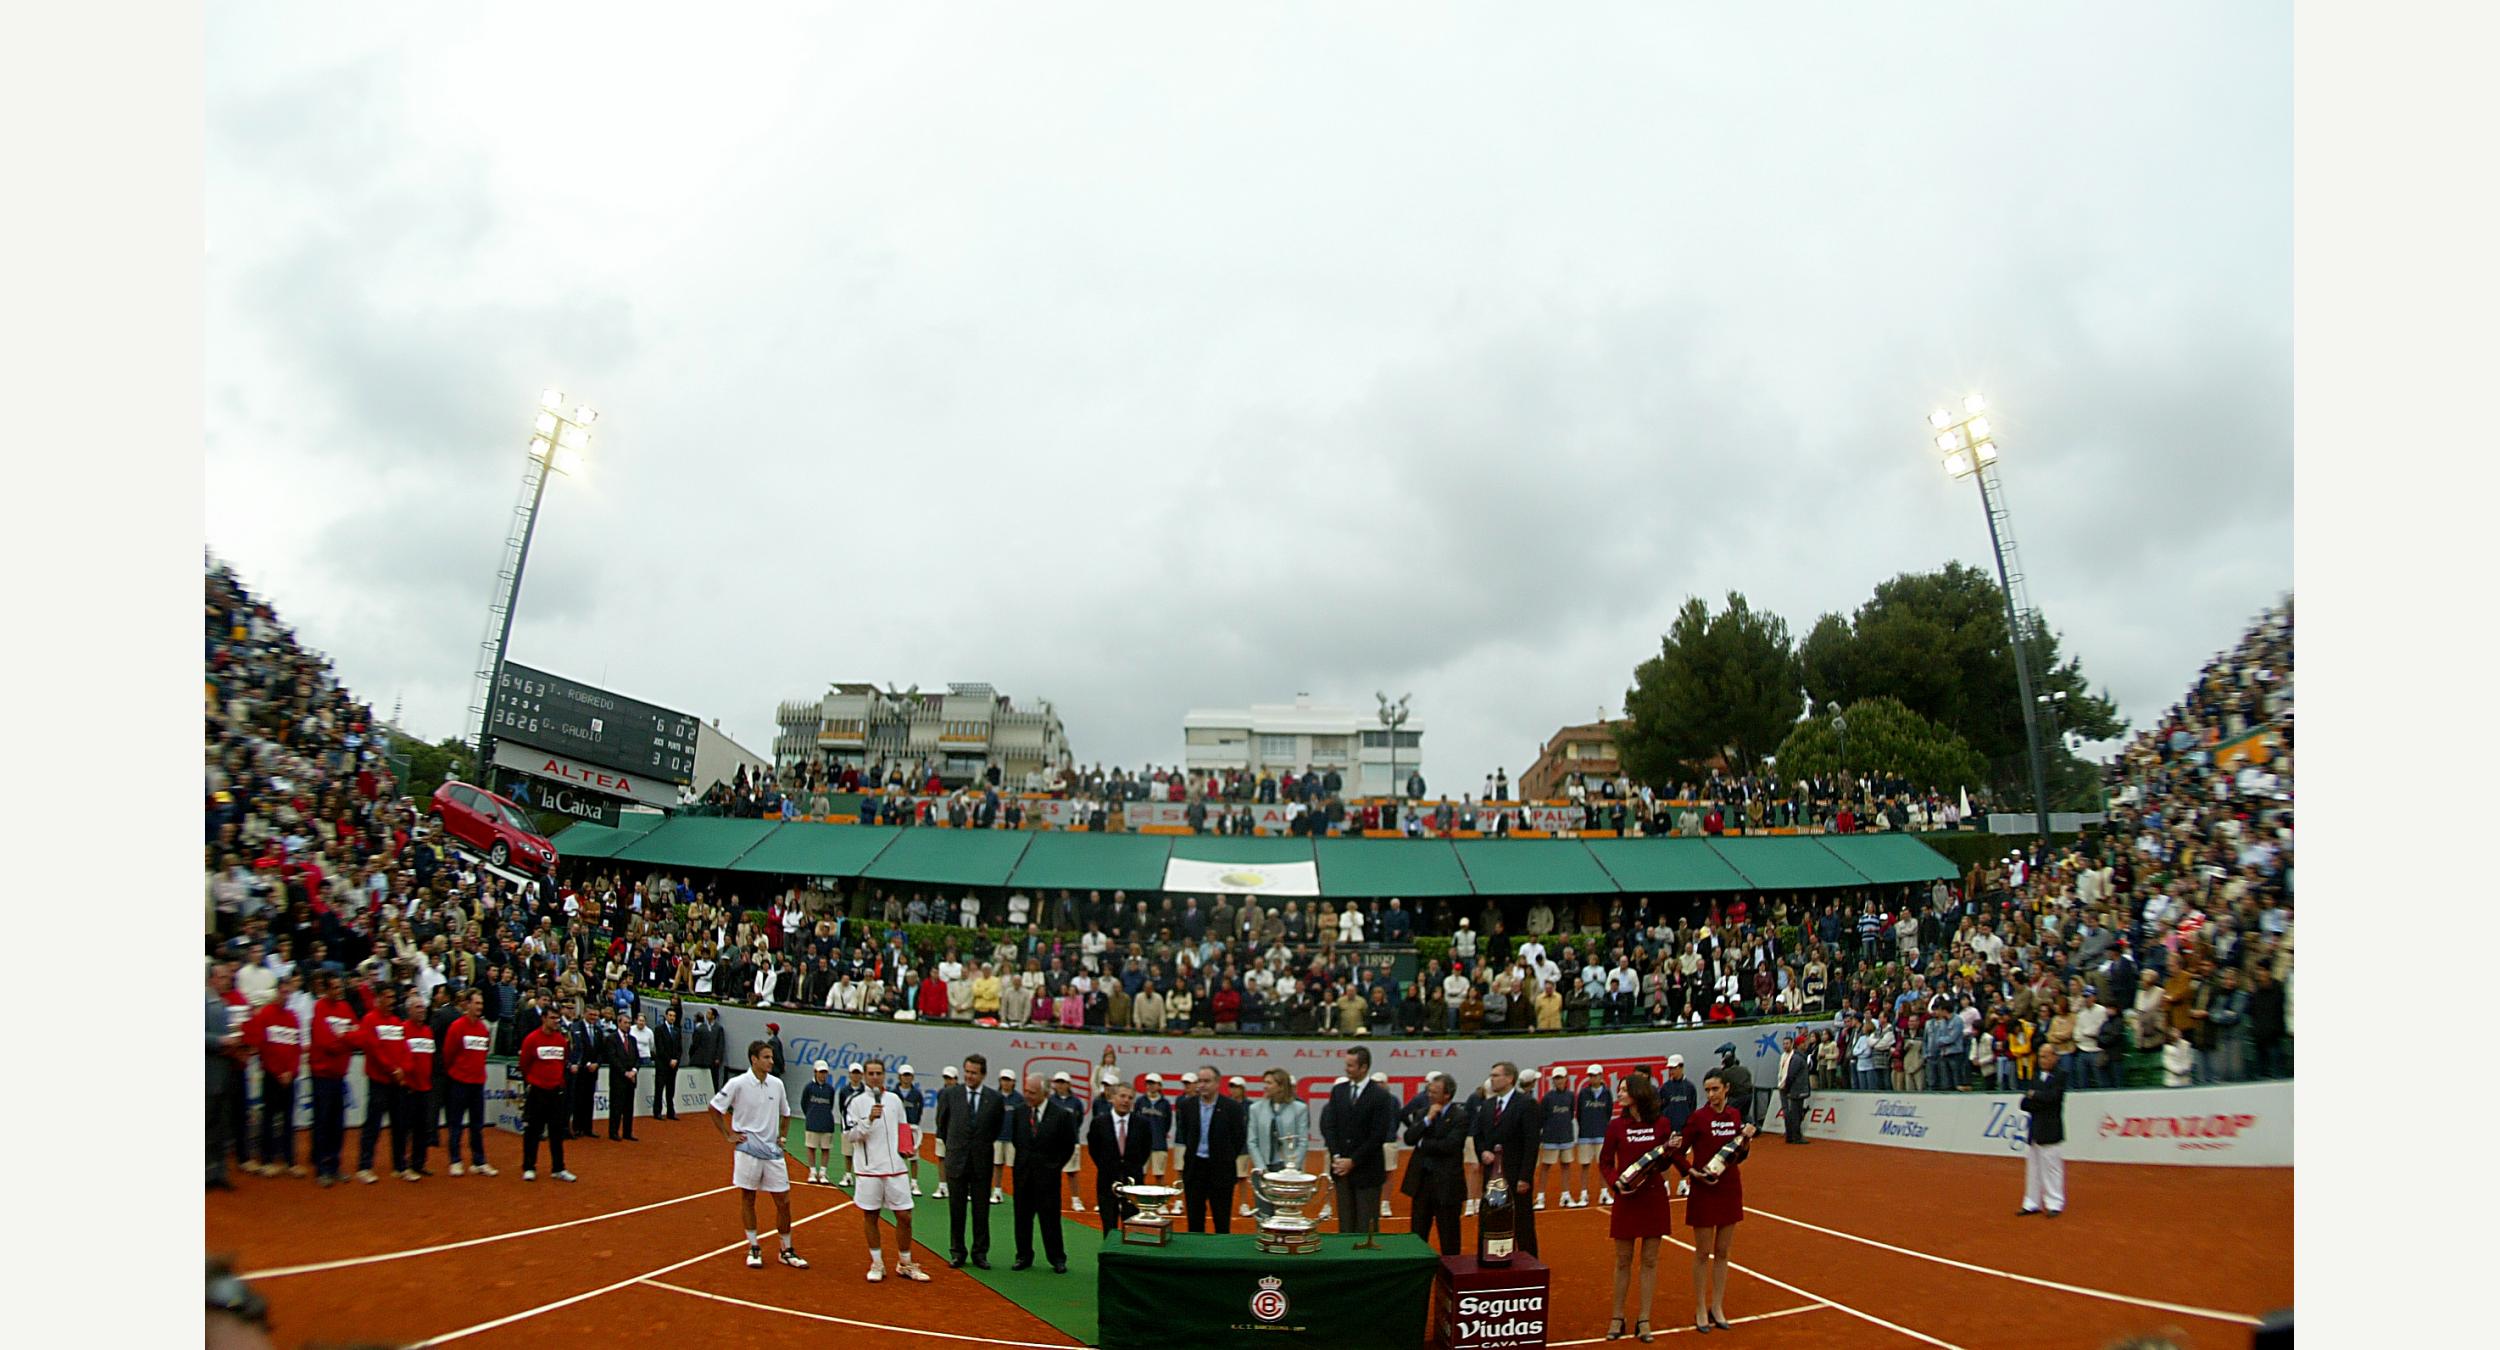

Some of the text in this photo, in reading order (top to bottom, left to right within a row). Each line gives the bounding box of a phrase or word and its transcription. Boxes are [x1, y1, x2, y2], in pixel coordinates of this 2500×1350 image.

[568, 689, 614, 711] ROBREDO
[657, 719, 665, 733] 6
[688, 728, 697, 741] 2
[562, 723, 603, 743] GAUDIO
[652, 752, 661, 766] 3
[683, 760, 692, 773] 2
[543, 759, 631, 792] ALTEA
[1010, 1039, 1078, 1051] ALTEA
[1104, 1044, 1173, 1056] ALTEA
[1198, 1046, 1269, 1058] ALTEA
[1295, 1048, 1348, 1058] ALTE
[1390, 1048, 1458, 1058] ALTEA
[1775, 1106, 1836, 1124] AEA
[1983, 1102, 2032, 1150] Zeg
[1458, 1297, 1543, 1318] Segura
[1457, 1318, 1544, 1339] Viudas
[1481, 1340, 1518, 1349] CAVA
